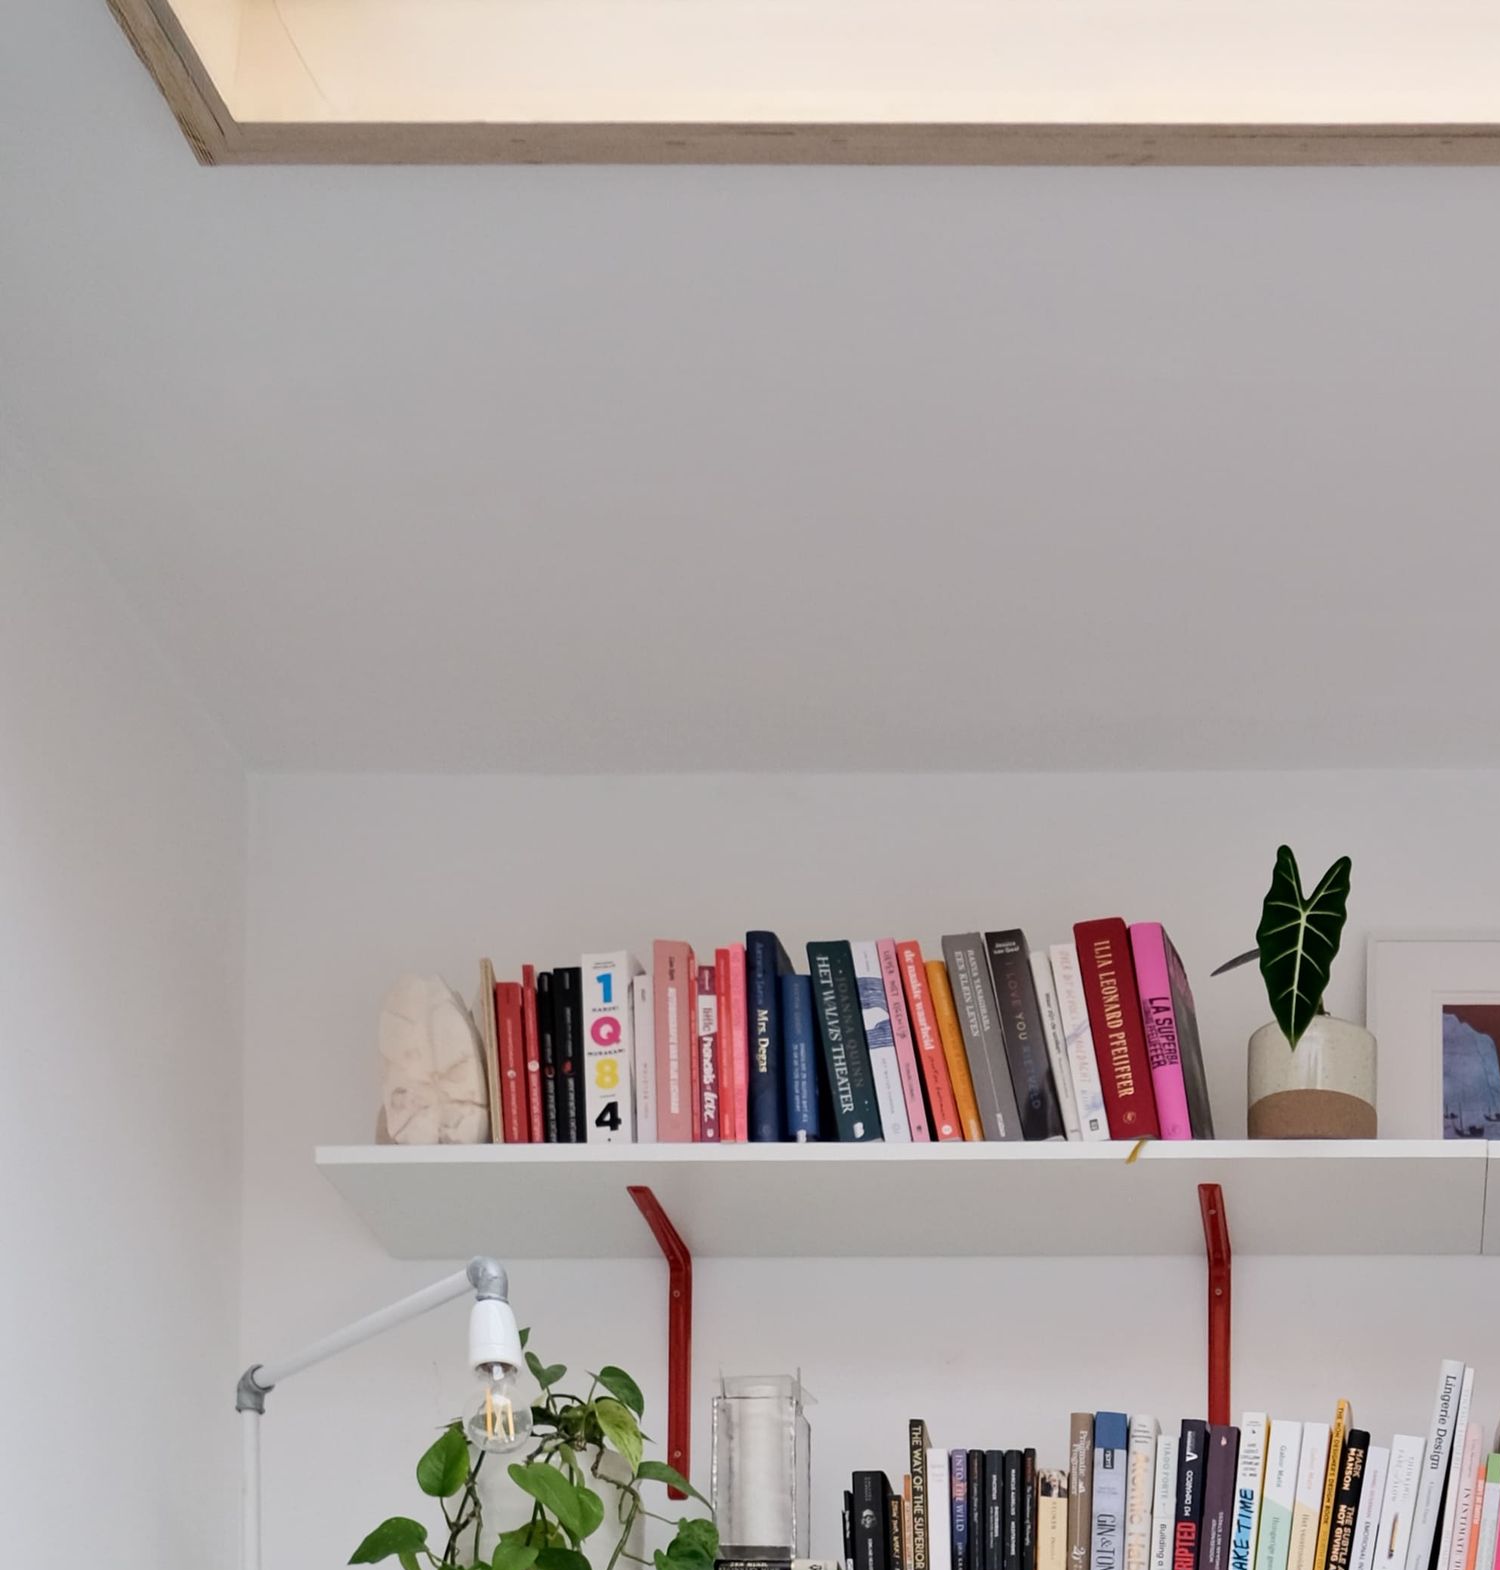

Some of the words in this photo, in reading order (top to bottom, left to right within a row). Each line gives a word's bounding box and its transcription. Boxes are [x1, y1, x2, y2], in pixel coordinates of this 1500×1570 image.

[1093, 940, 1113, 969] ILJA
[596, 973, 612, 1003] 1
[816, 956, 833, 990] HET
[1098, 970, 1124, 1029] LEONARD
[1149, 997, 1171, 1014] LA
[590, 1016, 621, 1047] Q
[822, 990, 841, 1042] WALVIS
[1015, 1012, 1029, 1041] YOU
[1156, 1018, 1179, 1065] SUPERBA
[595, 1058, 620, 1089] 8
[832, 1043, 855, 1114] THEATER
[1108, 1031, 1135, 1099] PFEIJFFER
[595, 1101, 622, 1131] 4
[1438, 1374, 1457, 1425] Lingerie
[912, 1425, 922, 1446] THE
[1429, 1428, 1448, 1470] Design
[912, 1448, 923, 1474] WAY
[955, 1455, 964, 1479] INTO
[1342, 1448, 1356, 1491] MANSON
[1352, 1449, 1365, 1478] MARK
[913, 1475, 923, 1492] OF
[1130, 1451, 1150, 1525] Atomic
[914, 1494, 924, 1515] THE
[956, 1504, 965, 1532] WILD
[1234, 1487, 1255, 1532] TIME
[1336, 1505, 1347, 1525] NOT
[1345, 1506, 1355, 1525] THE
[914, 1516, 925, 1569] SUPERIOR
[1156, 1523, 1168, 1558] Building
[1330, 1527, 1343, 1561] GIVING
[1338, 1527, 1352, 1565] SUBTLE
[1329, 1563, 1337, 1570] A
